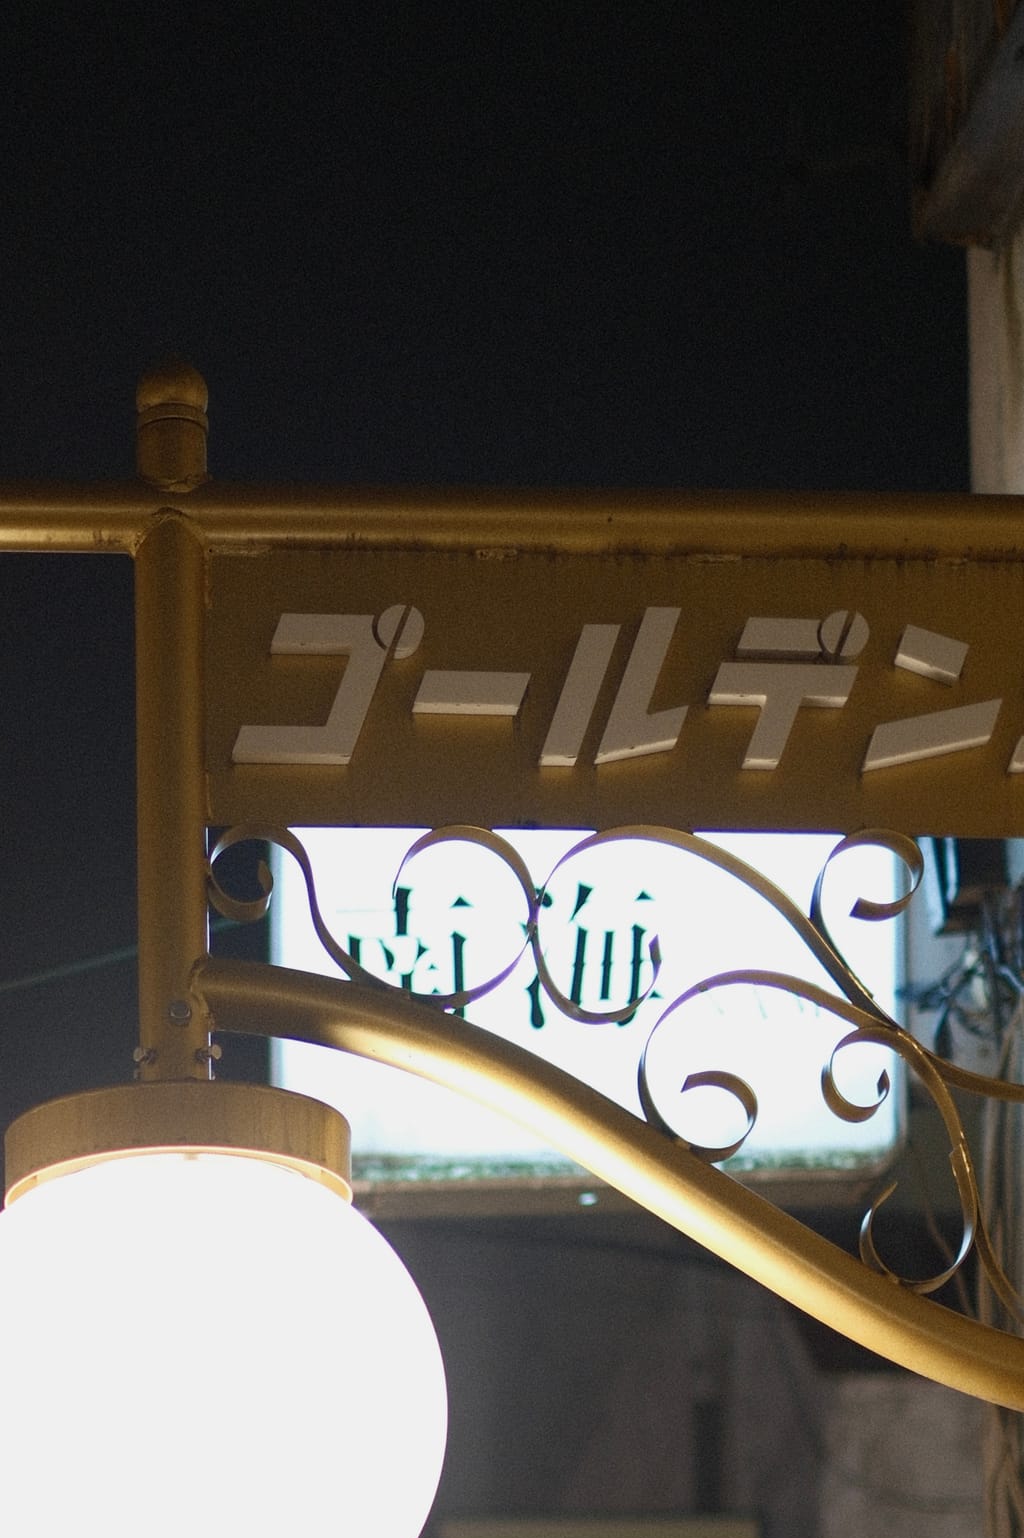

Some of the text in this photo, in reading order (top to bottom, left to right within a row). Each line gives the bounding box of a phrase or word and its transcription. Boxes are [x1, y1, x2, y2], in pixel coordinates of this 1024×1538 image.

[231, 603, 1024, 773] ゴールデン
